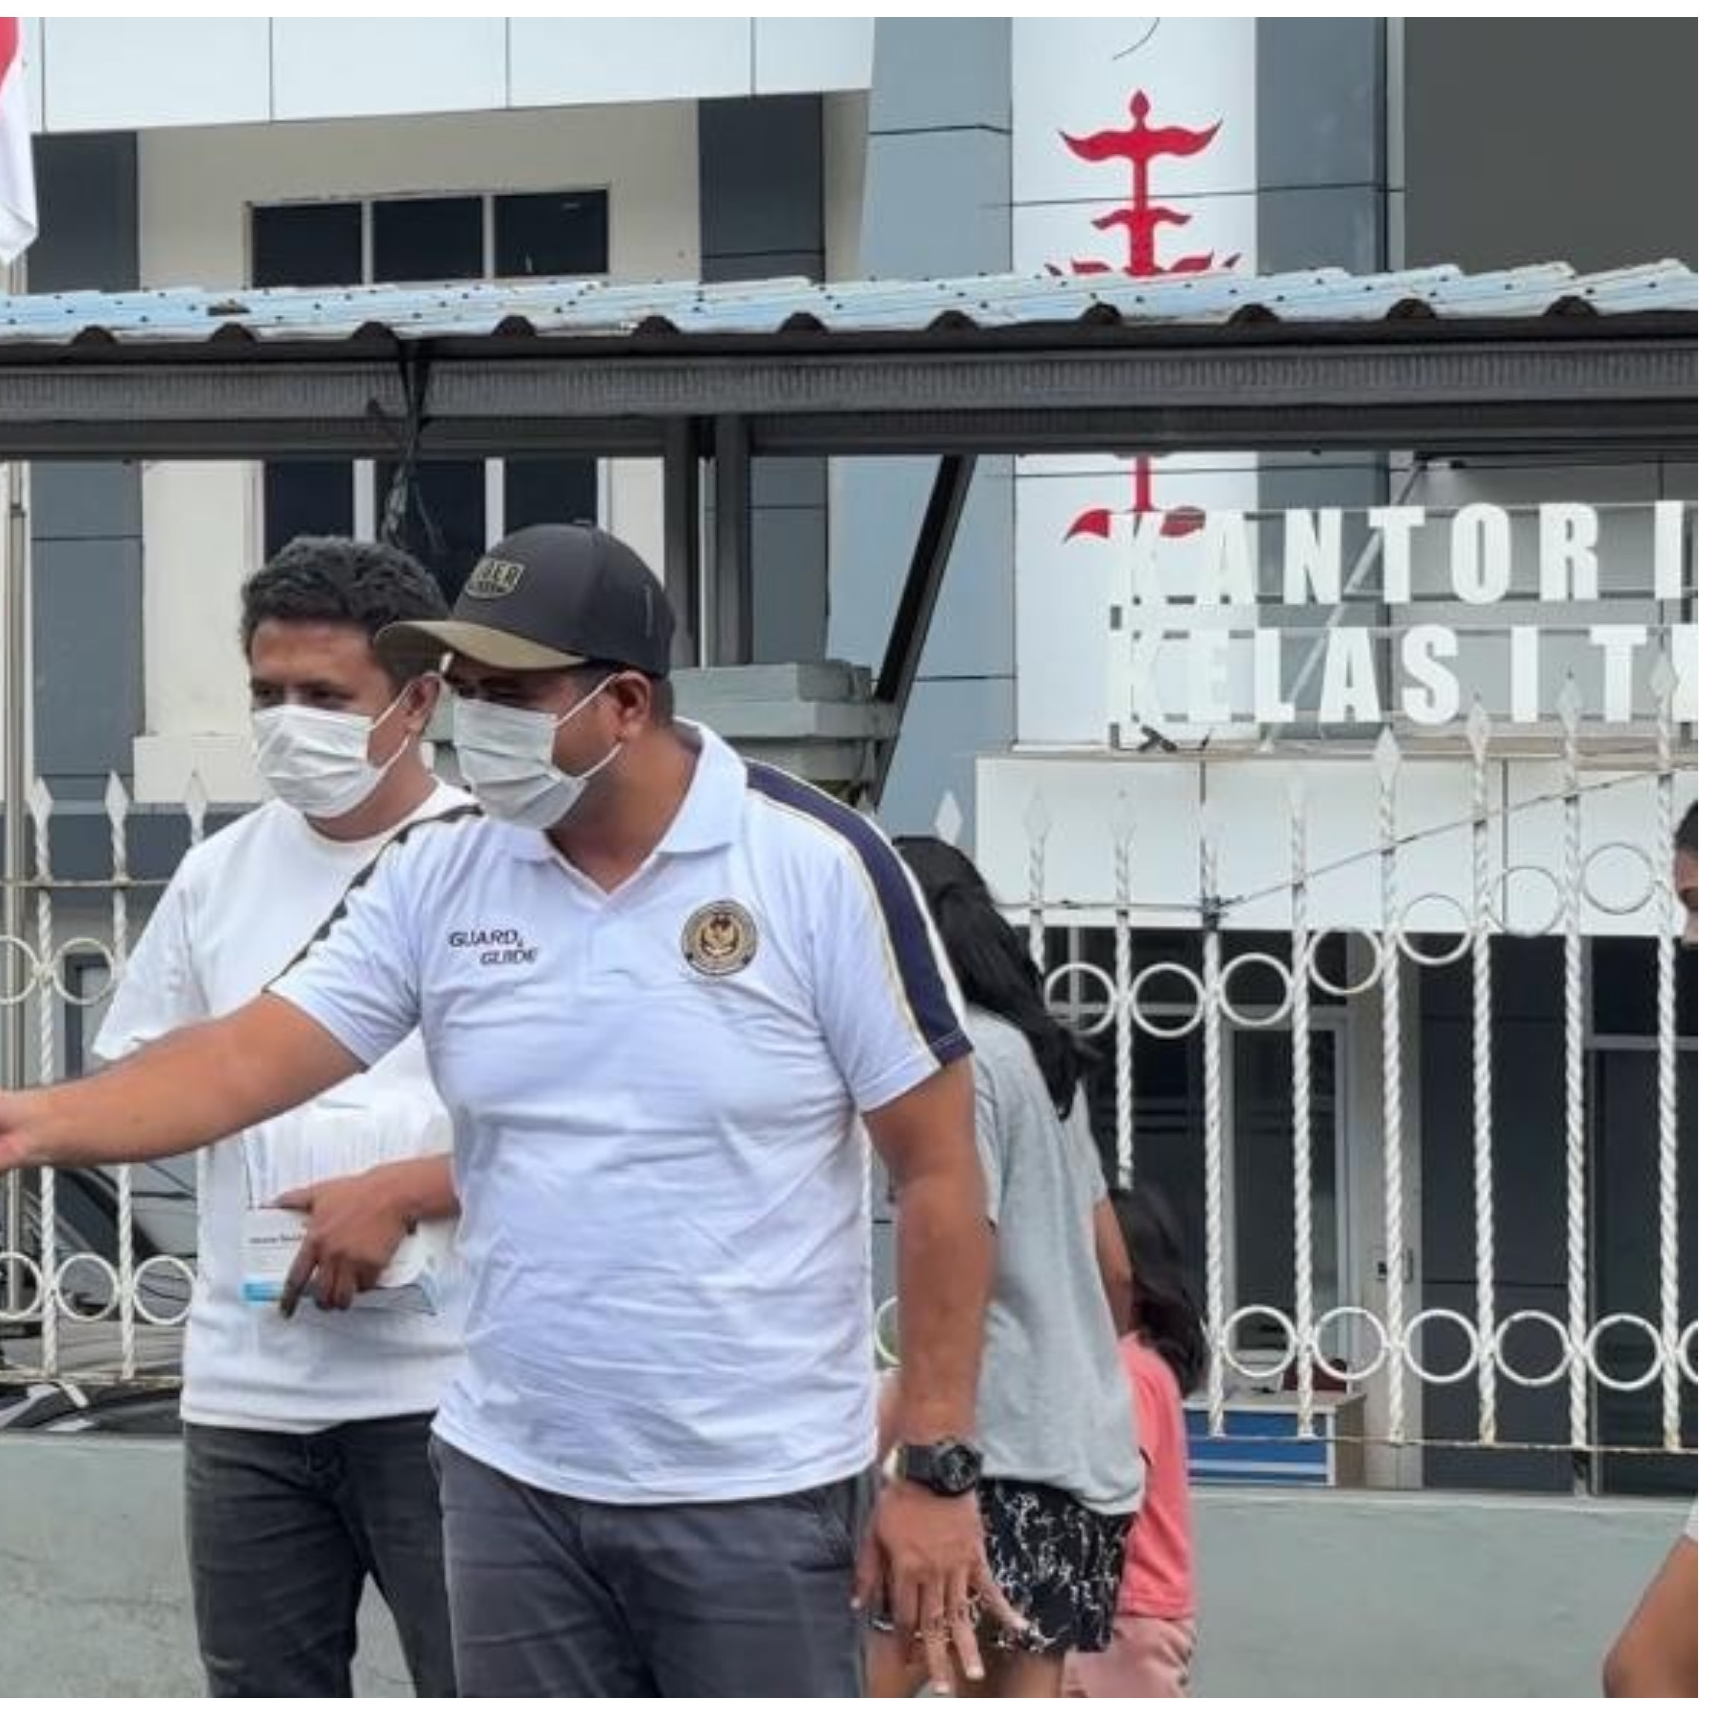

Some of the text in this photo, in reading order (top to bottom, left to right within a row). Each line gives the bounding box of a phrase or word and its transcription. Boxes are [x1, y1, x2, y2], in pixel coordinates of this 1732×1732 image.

[1109, 502, 1600, 605] KANTOR
[1108, 624, 1462, 724] KELAS
[1510, 626, 1539, 723] I
[480, 948, 539, 965] GUIDE
